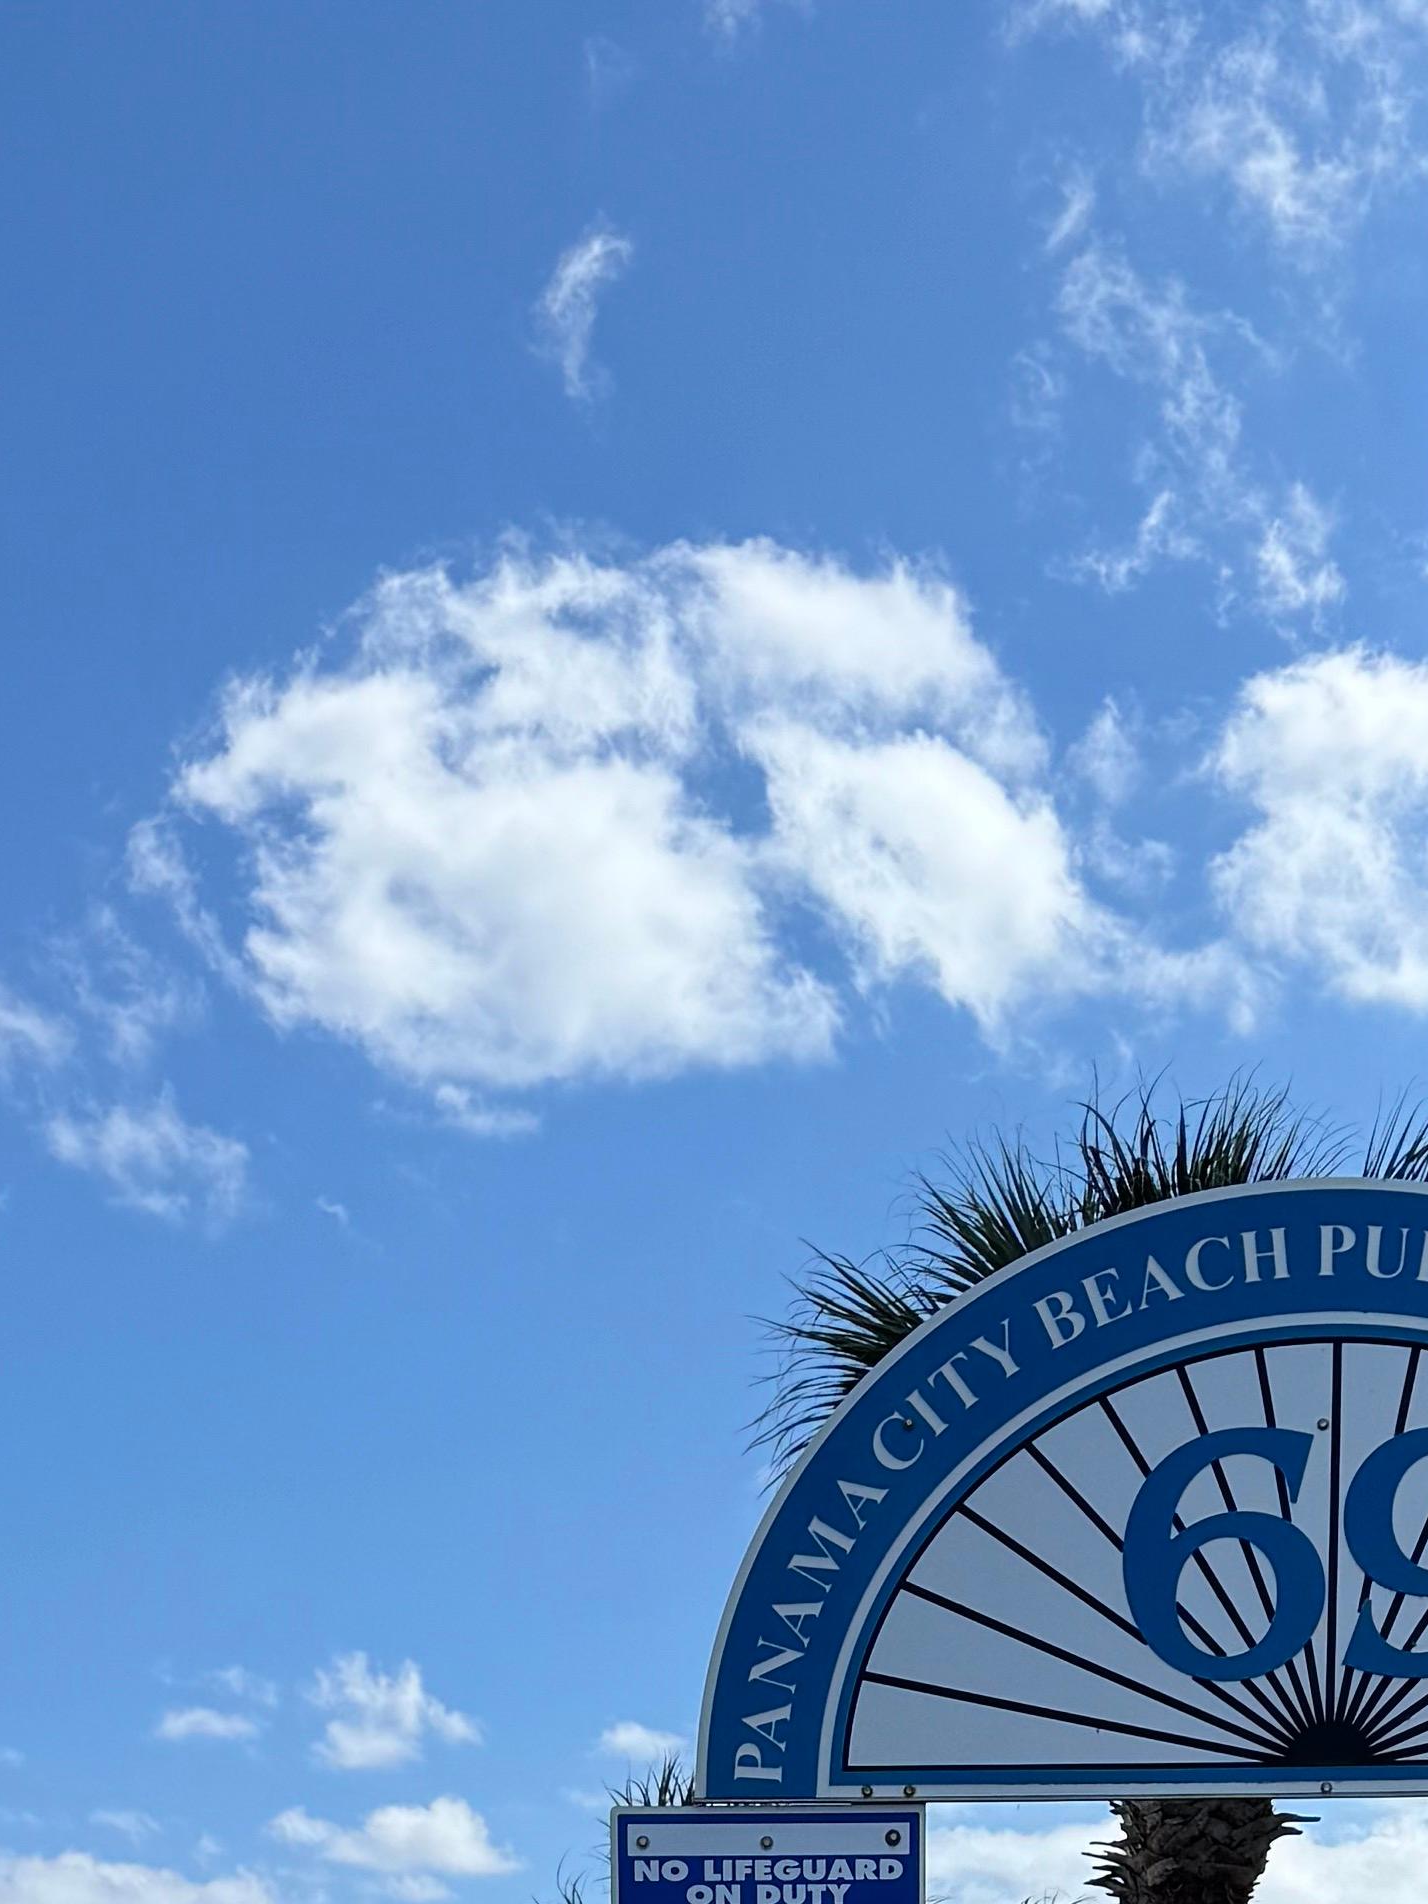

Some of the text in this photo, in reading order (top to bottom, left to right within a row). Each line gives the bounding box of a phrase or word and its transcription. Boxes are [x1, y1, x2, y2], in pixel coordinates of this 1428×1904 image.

[734, 1480, 889, 1783] PANAMA
[873, 1318, 1020, 1470] CITY
[1033, 1227, 1290, 1350] BEACH
[634, 1859, 903, 1882] NO LIFEGUARD
[757, 1884, 850, 1904] DUTY
